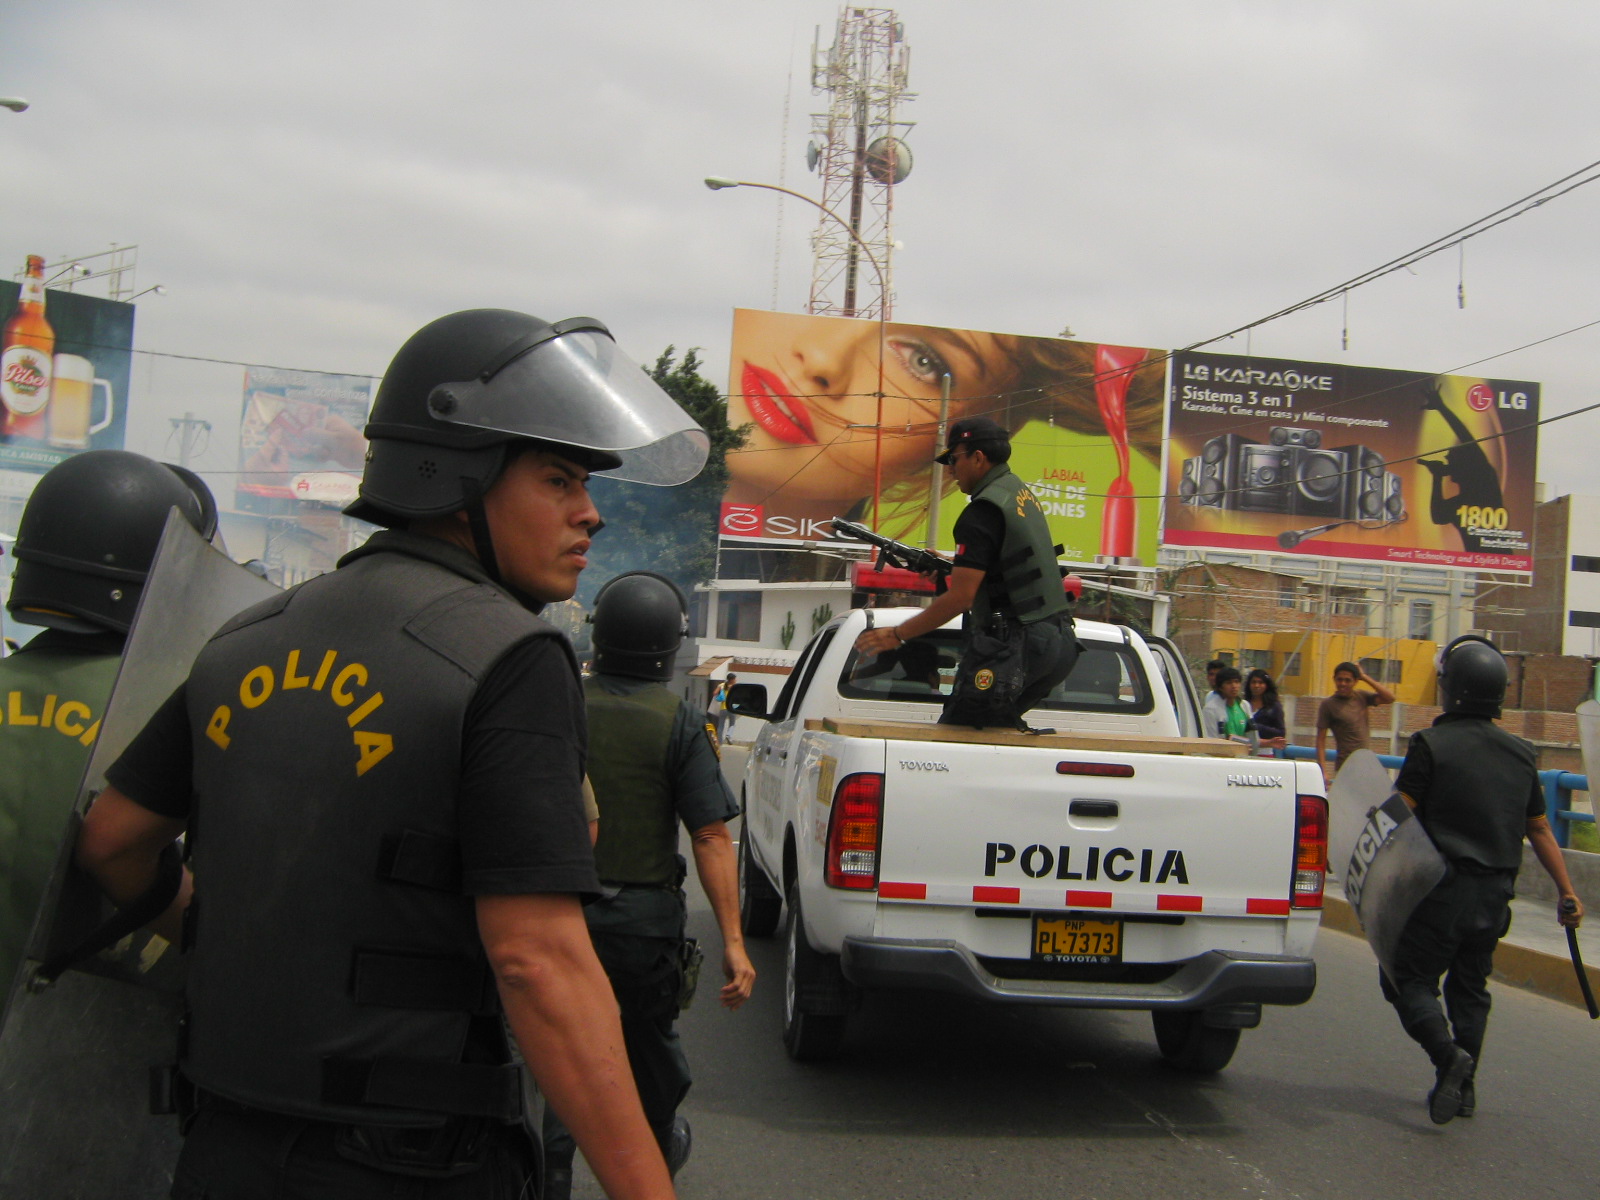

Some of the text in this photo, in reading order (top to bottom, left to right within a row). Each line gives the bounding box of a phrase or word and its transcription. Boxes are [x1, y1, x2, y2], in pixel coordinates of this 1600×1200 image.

[5, 363, 49, 388] Pilsen
[1183, 363, 1333, 391] LG KARAOKE
[1182, 385, 1293, 408] Sistema 3 en 1
[1498, 391, 1528, 410] LG
[1181, 400, 1389, 428] Karaoke, Cine en casa y Mini componente
[1043, 467, 1087, 483] LABIAL
[1065, 485, 1087, 501] DE
[1456, 504, 1509, 530] 1800
[1387, 548, 1528, 569] Smart Technology and Stylish Design
[205, 649, 394, 778] POLICIA
[899, 760, 950, 772] TOYOTA
[1227, 774, 1282, 788] HILUX
[984, 842, 1189, 884] POLICIA
[1064, 920, 1085, 931] PNP
[1056, 954, 1098, 963] TOYOTA
